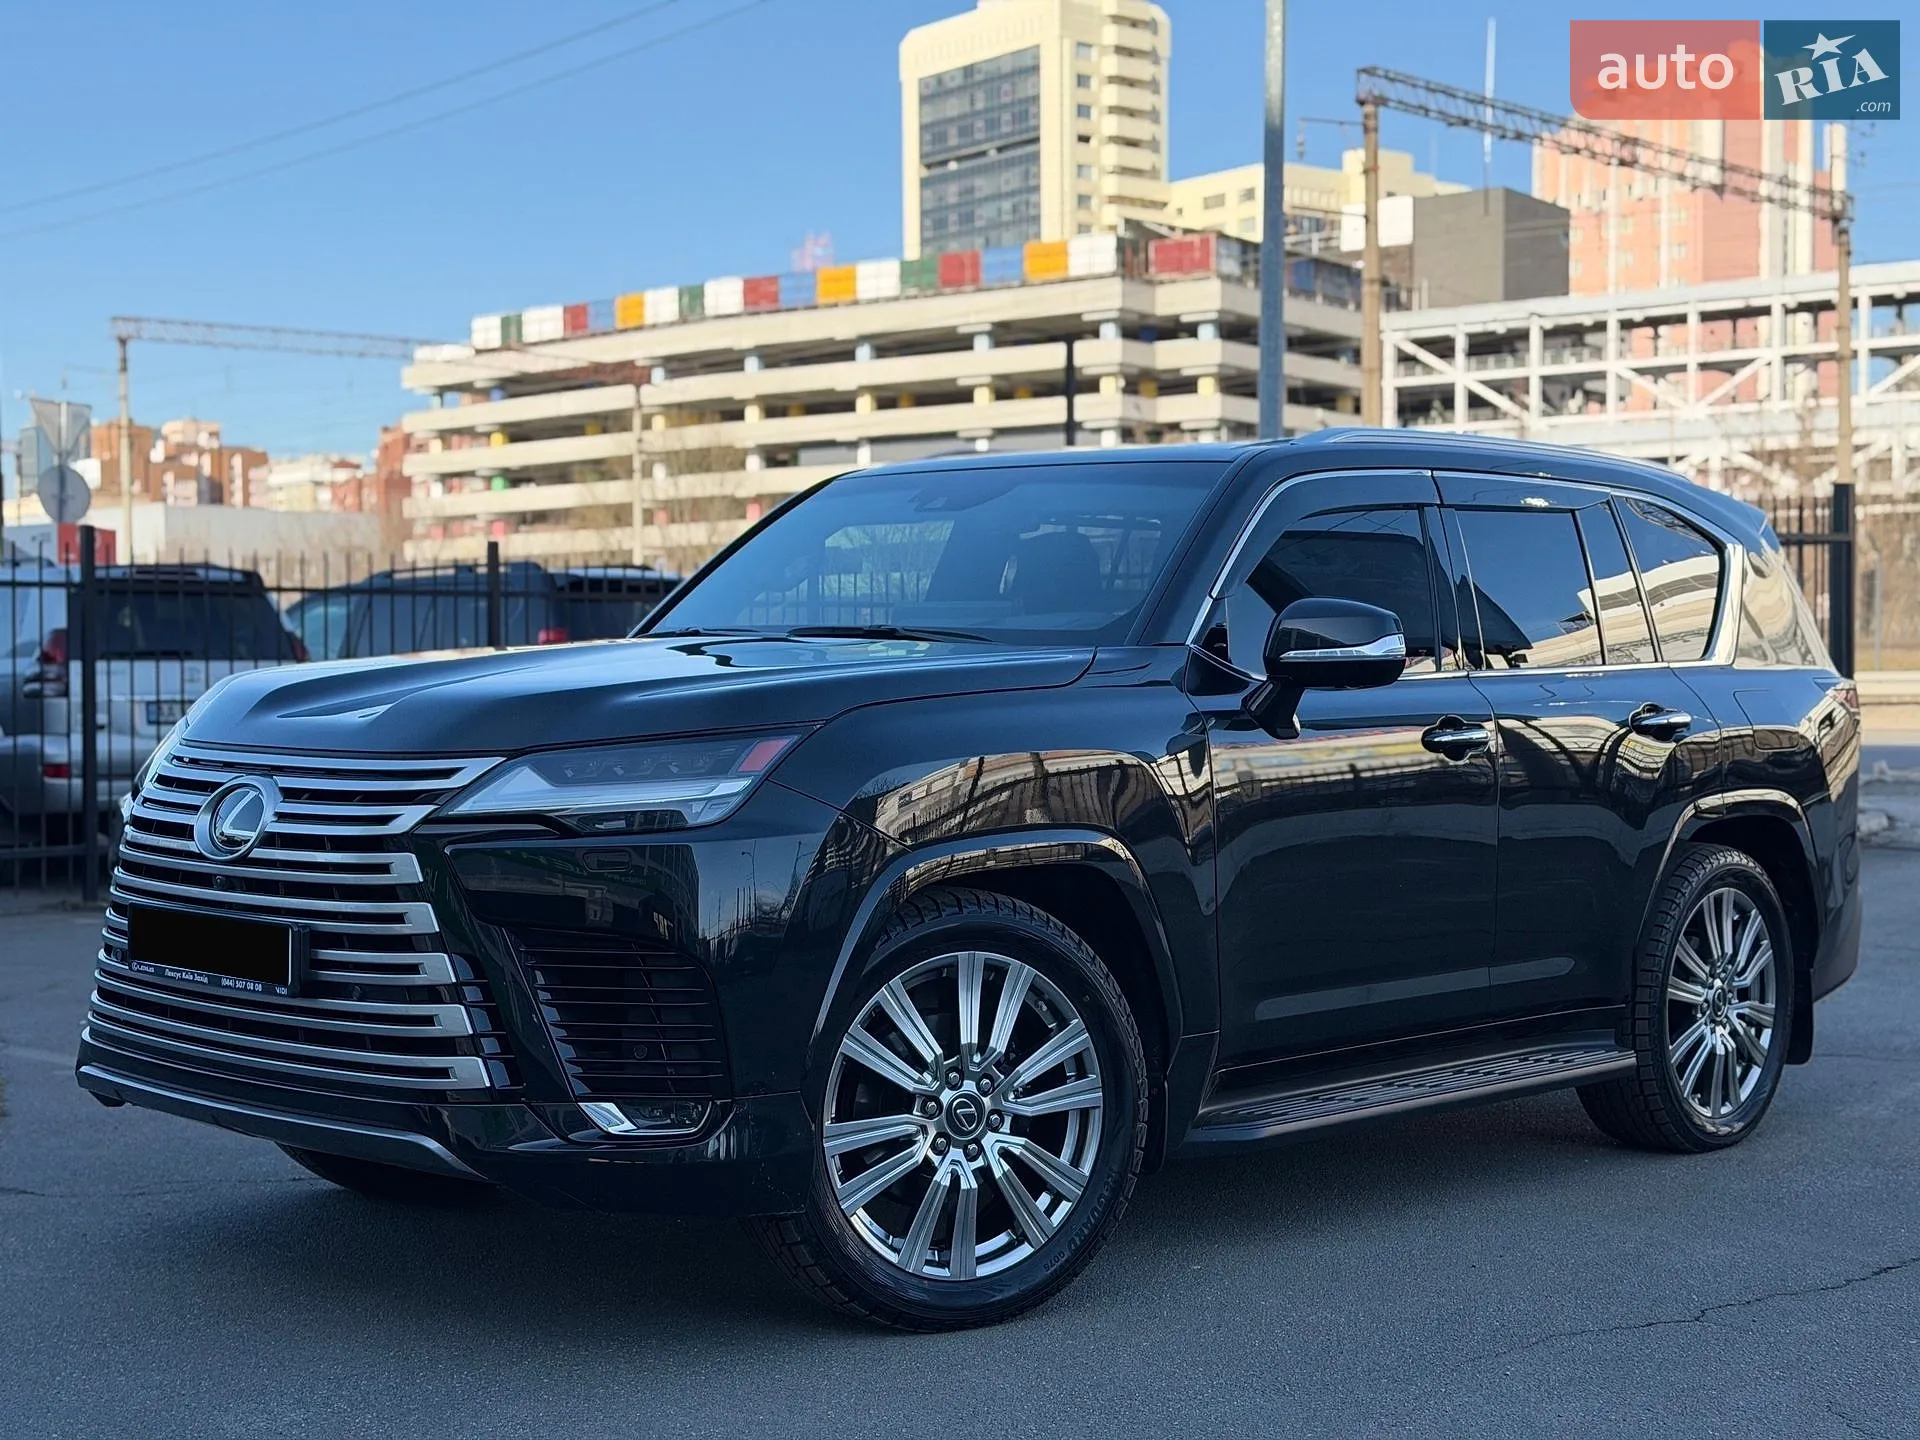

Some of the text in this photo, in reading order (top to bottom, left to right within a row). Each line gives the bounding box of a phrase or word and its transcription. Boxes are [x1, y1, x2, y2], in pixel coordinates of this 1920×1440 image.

[221, 977, 263, 992] (044) 507 08 08
